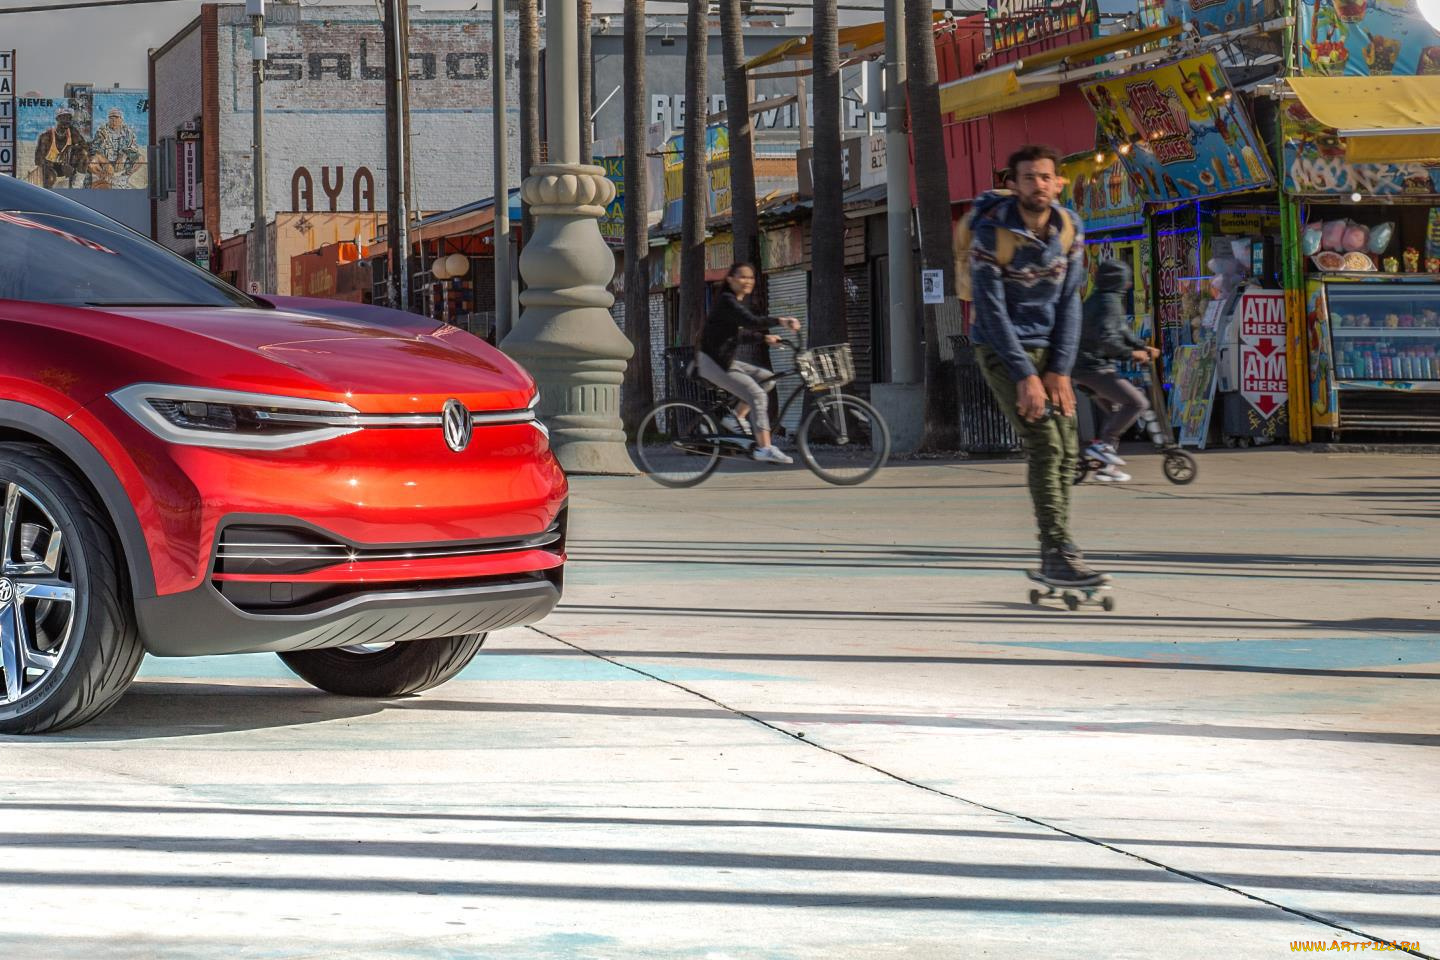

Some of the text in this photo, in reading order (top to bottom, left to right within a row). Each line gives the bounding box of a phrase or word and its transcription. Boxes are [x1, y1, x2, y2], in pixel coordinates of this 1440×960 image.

[0, 53, 11, 173] TATTO
[18, 98, 54, 108] NEVER
[291, 166, 375, 212] AYA
[1244, 298, 1286, 323] ATM
[1244, 324, 1287, 334] HERE
[1245, 354, 1287, 380] ATM
[1246, 381, 1288, 391] HERE
